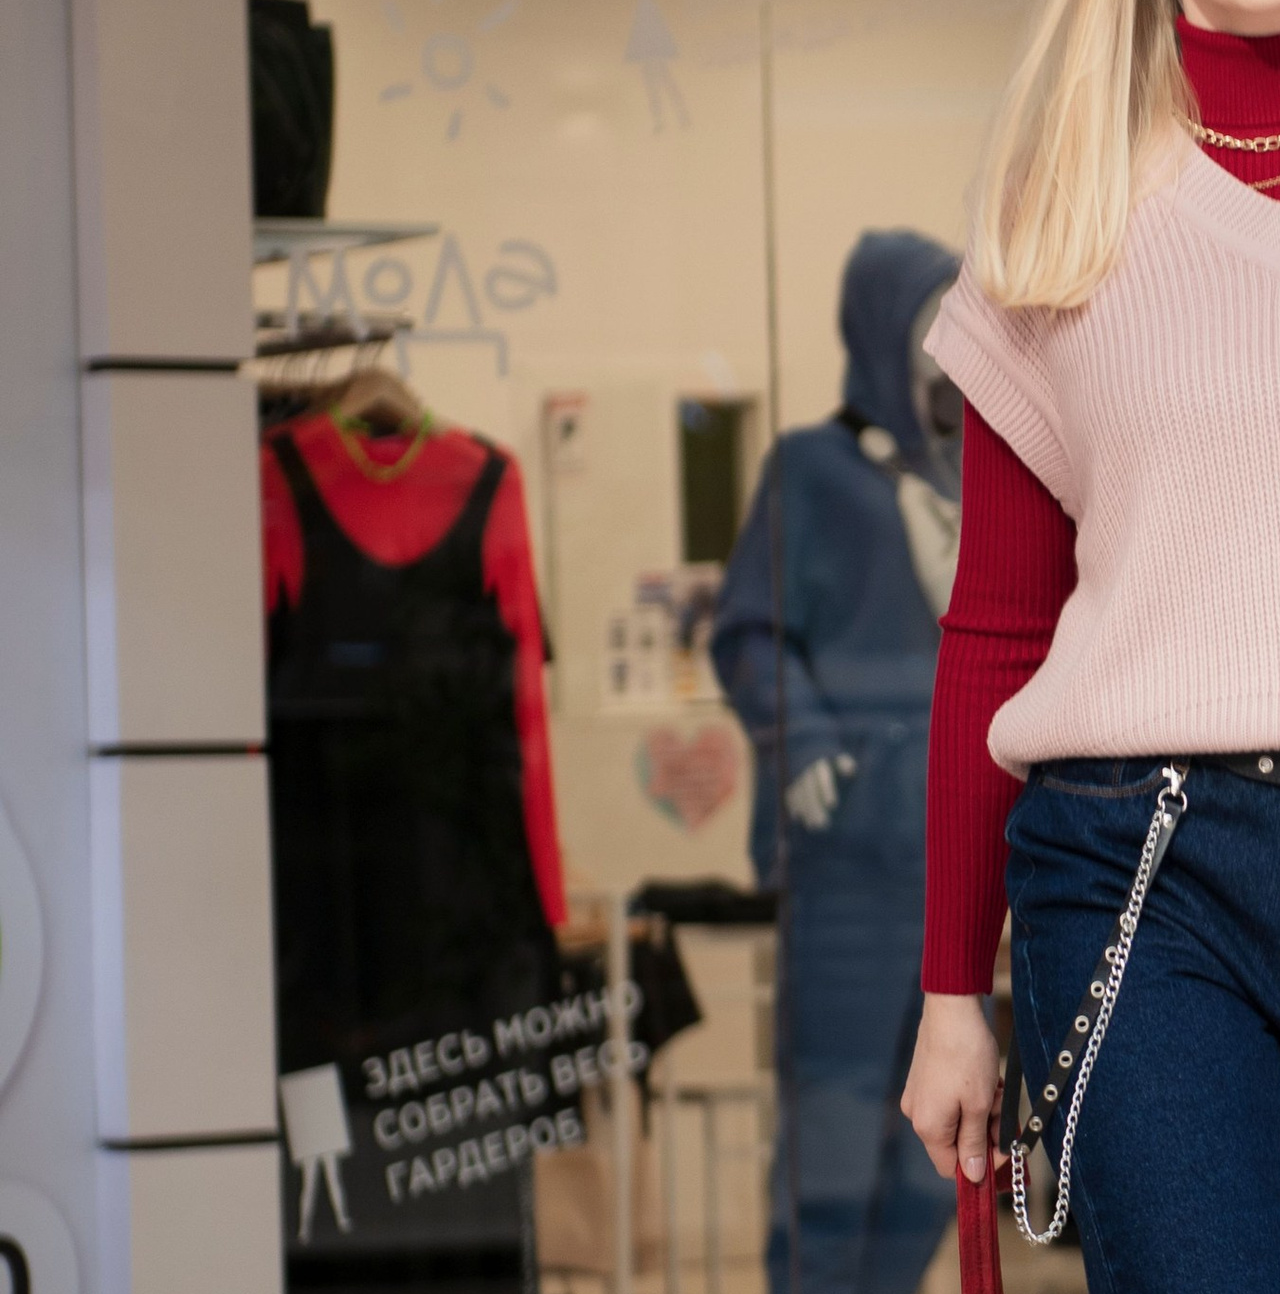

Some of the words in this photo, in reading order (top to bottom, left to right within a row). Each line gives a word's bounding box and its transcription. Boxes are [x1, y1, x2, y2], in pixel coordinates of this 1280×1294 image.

[362, 1030, 491, 1099] ЗДЕСЬ
[494, 980, 643, 1055] МОЖНО
[374, 1068, 549, 1149] СОБРАТЬ
[386, 1108, 584, 1202] ГАРДЕРОБ
